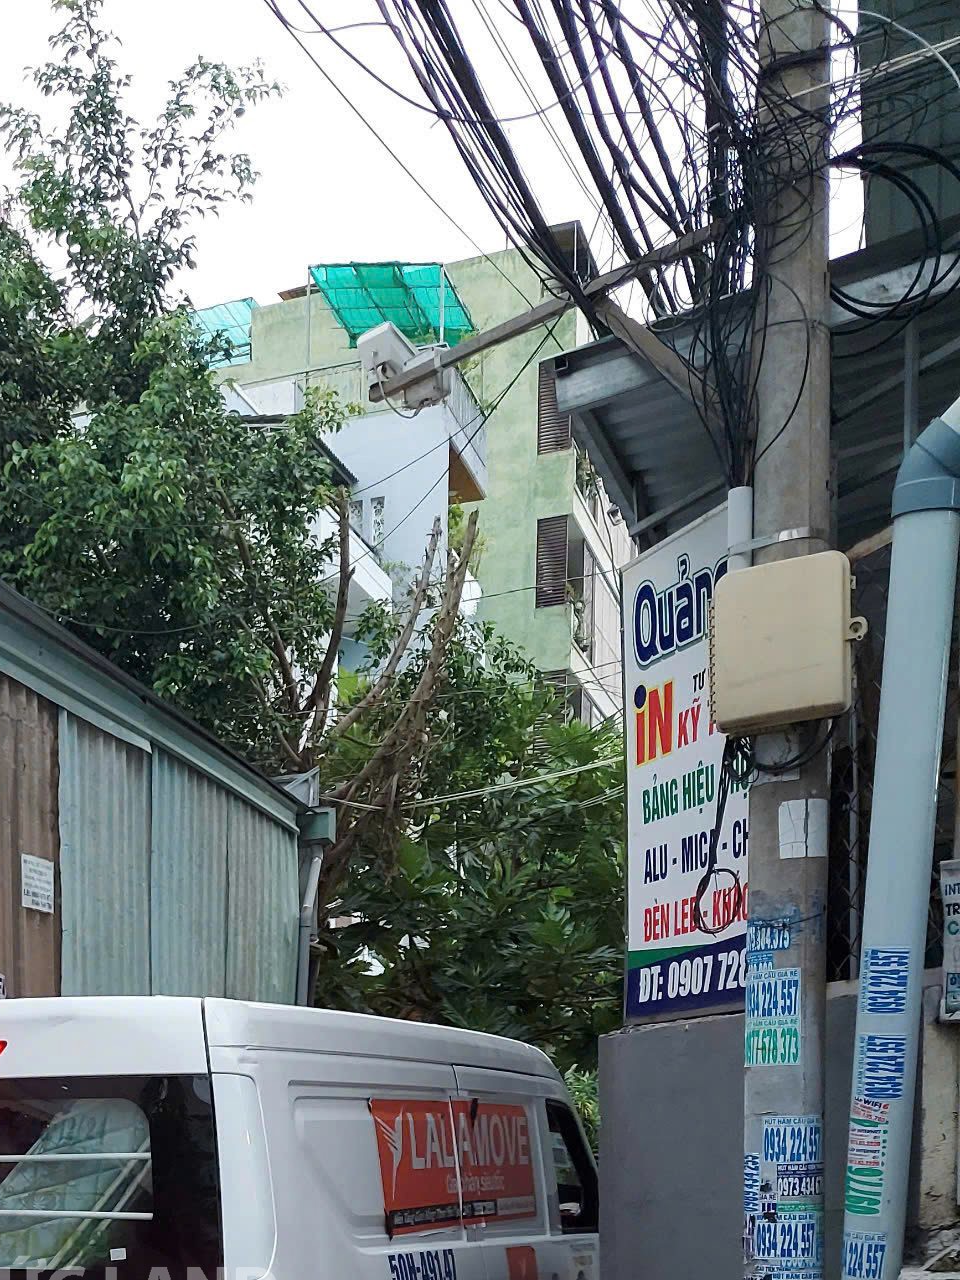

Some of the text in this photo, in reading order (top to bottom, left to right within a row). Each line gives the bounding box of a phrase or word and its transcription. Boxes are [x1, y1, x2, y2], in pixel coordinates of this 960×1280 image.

[677, 697, 702, 749] KỸ
[642, 774, 679, 825] BẢNG
[682, 760, 715, 815] HIỆU
[644, 843, 668, 885] ALU
[644, 898, 670, 943] ĐÈN
[638, 966, 663, 1003] ĐT:
[667, 955, 713, 999] 0907
[406, 1111, 529, 1171] LALAMOVE
[756, 1223, 815, 1258] 0934.224.557
